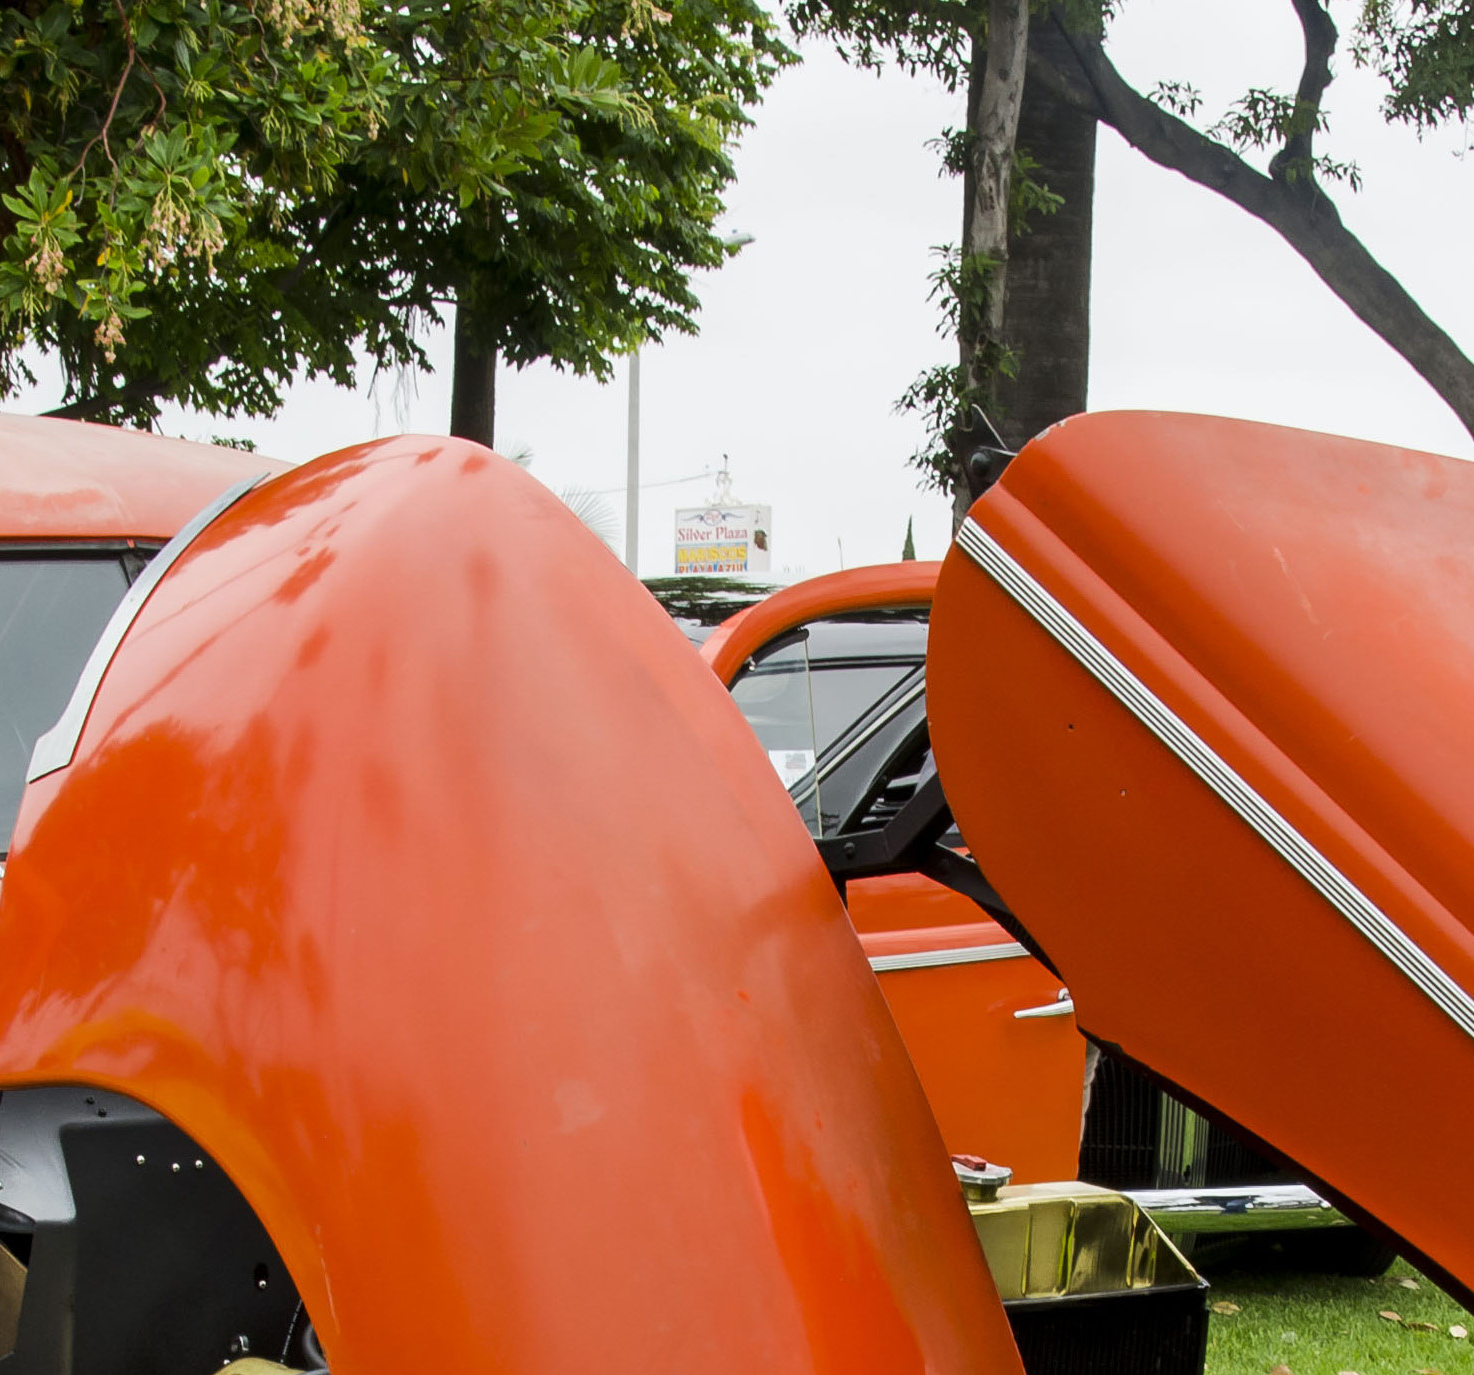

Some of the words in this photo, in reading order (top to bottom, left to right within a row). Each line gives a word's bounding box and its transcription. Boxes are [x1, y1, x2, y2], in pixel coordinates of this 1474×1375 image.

[678, 527, 712, 541] Silver
[716, 526, 747, 539] Plaza
[678, 545, 746, 563] MARISCOS
